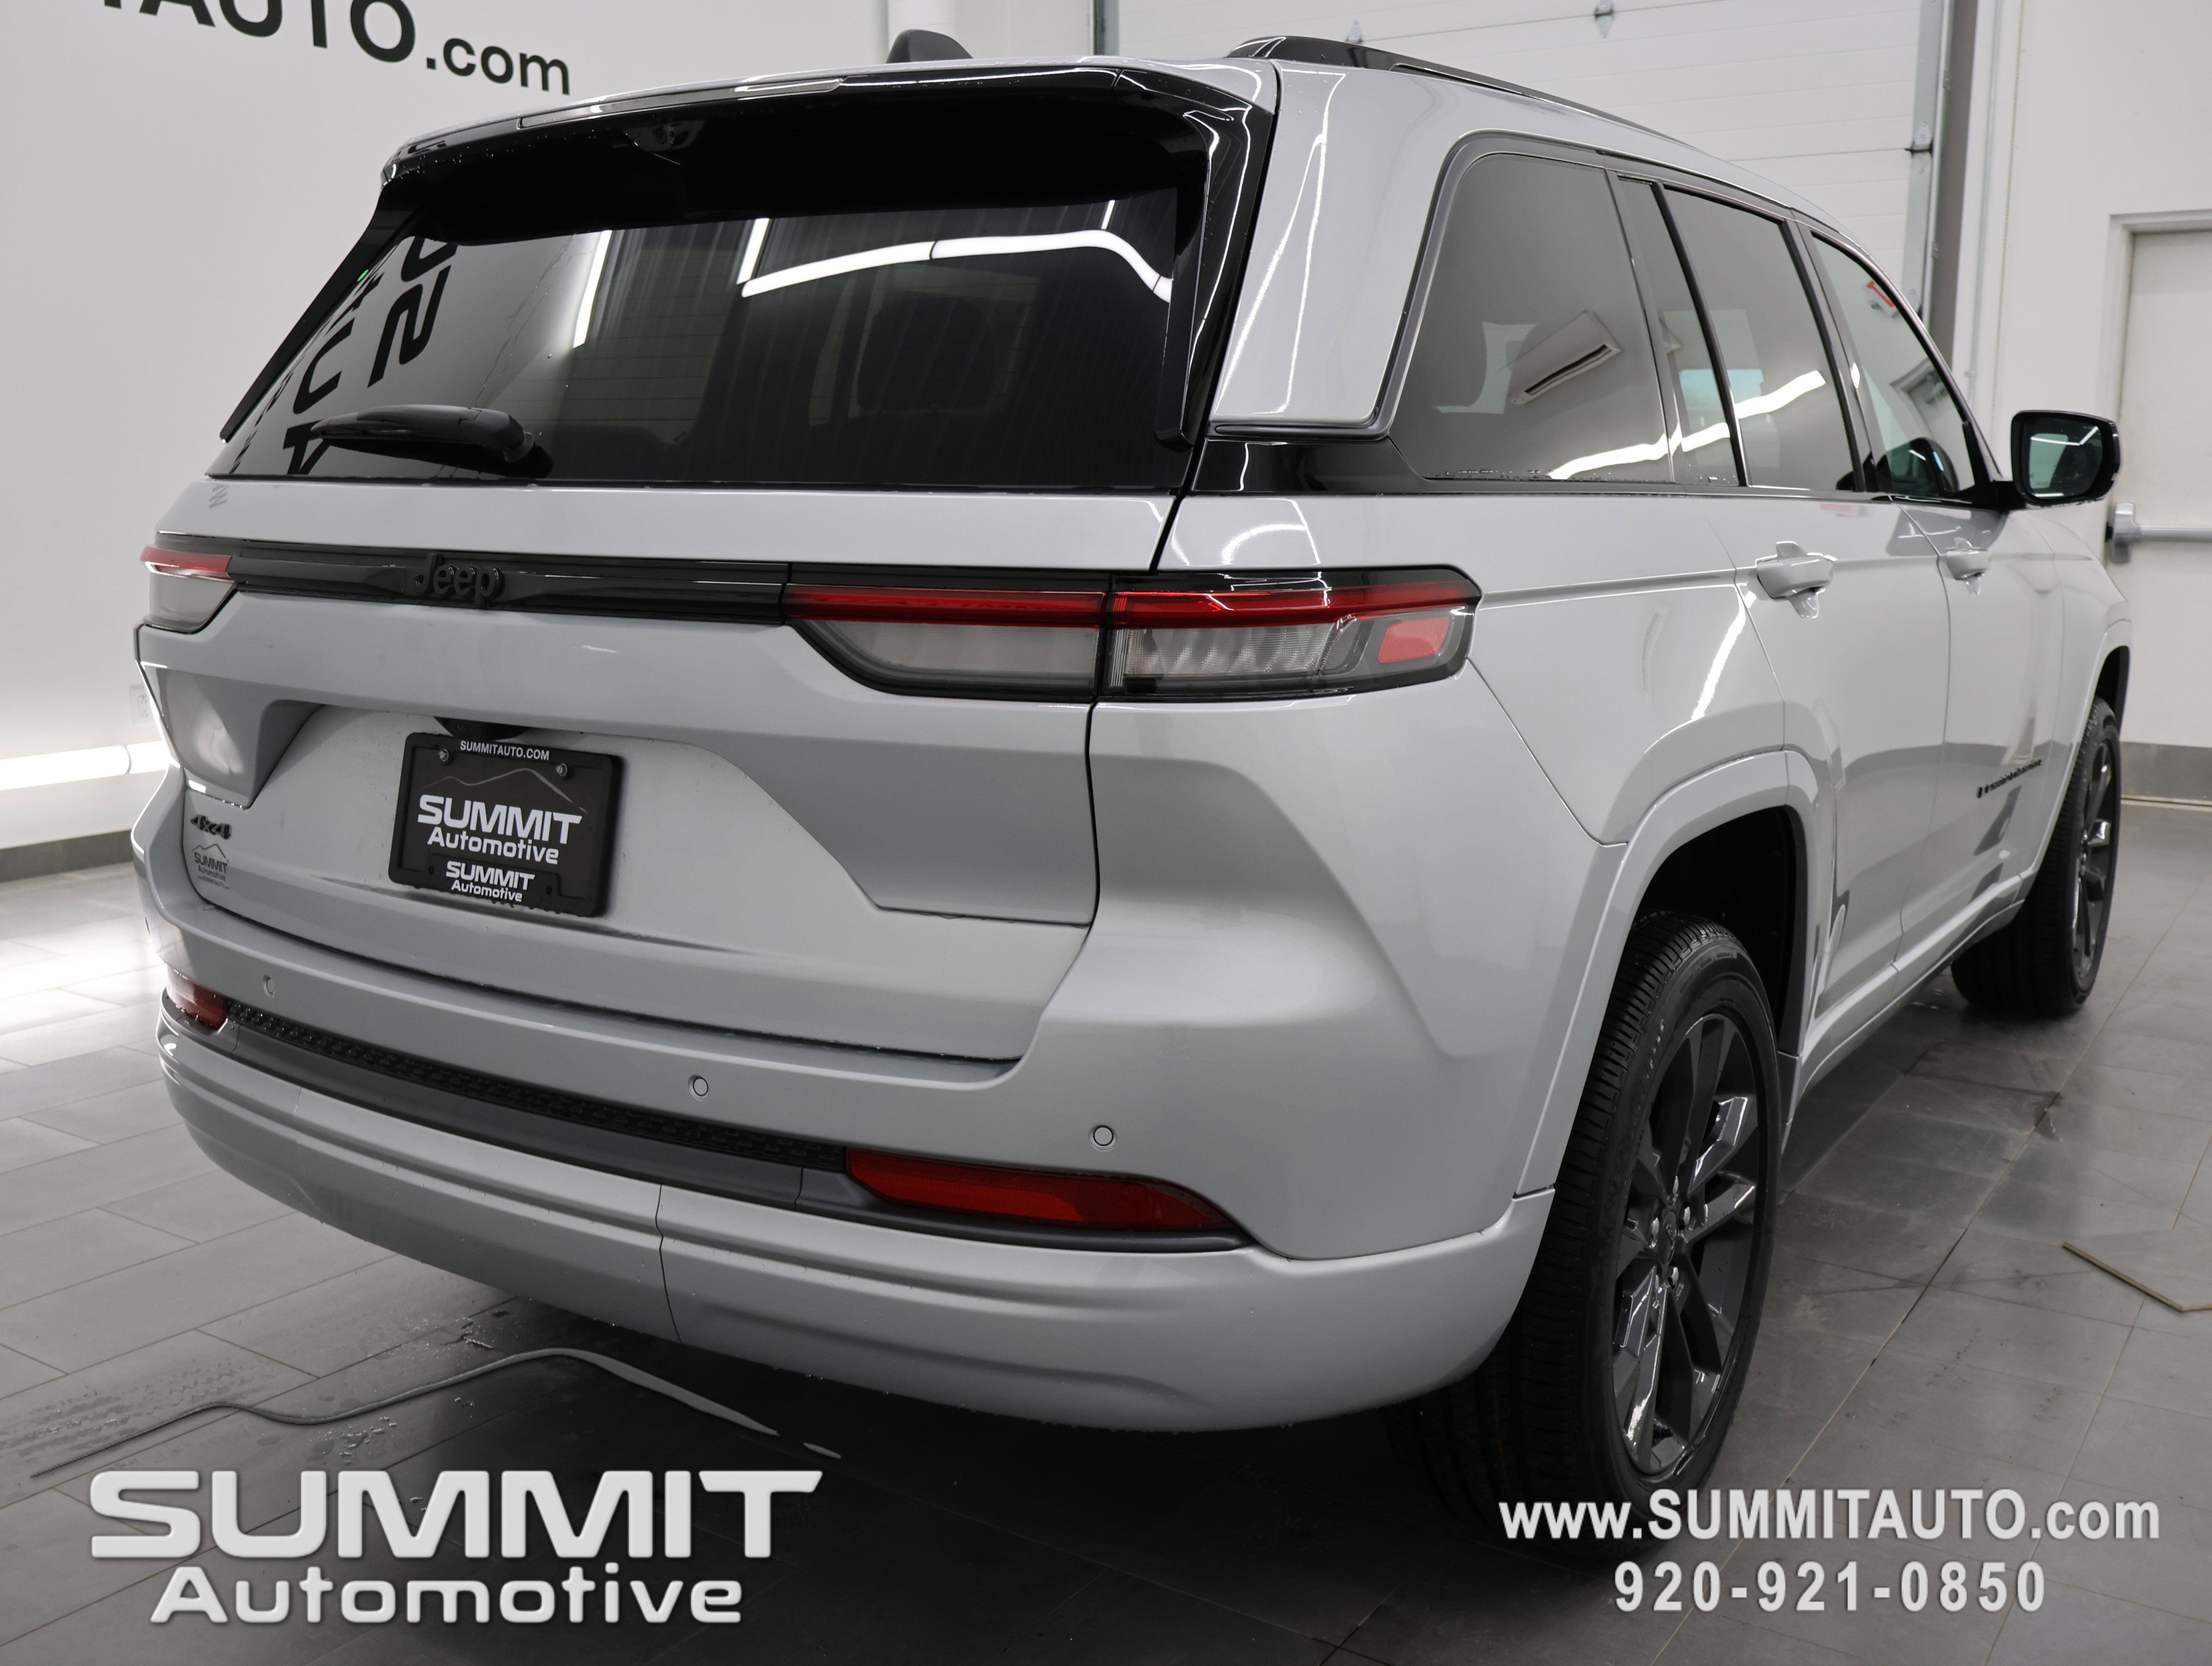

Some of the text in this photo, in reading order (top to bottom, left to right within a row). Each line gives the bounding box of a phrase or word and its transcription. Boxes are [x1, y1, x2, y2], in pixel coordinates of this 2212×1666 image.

[104, 0, 570, 95] UTO.com
[410, 554, 504, 609] Jeep
[460, 740, 550, 760] SUMMITAUTO.COM
[418, 794, 582, 845] SUMMIT
[427, 826, 559, 865] Automotive
[194, 852, 228, 874] SUMMIT
[445, 860, 536, 890] SUMMIT
[450, 880, 523, 902] Automotive
